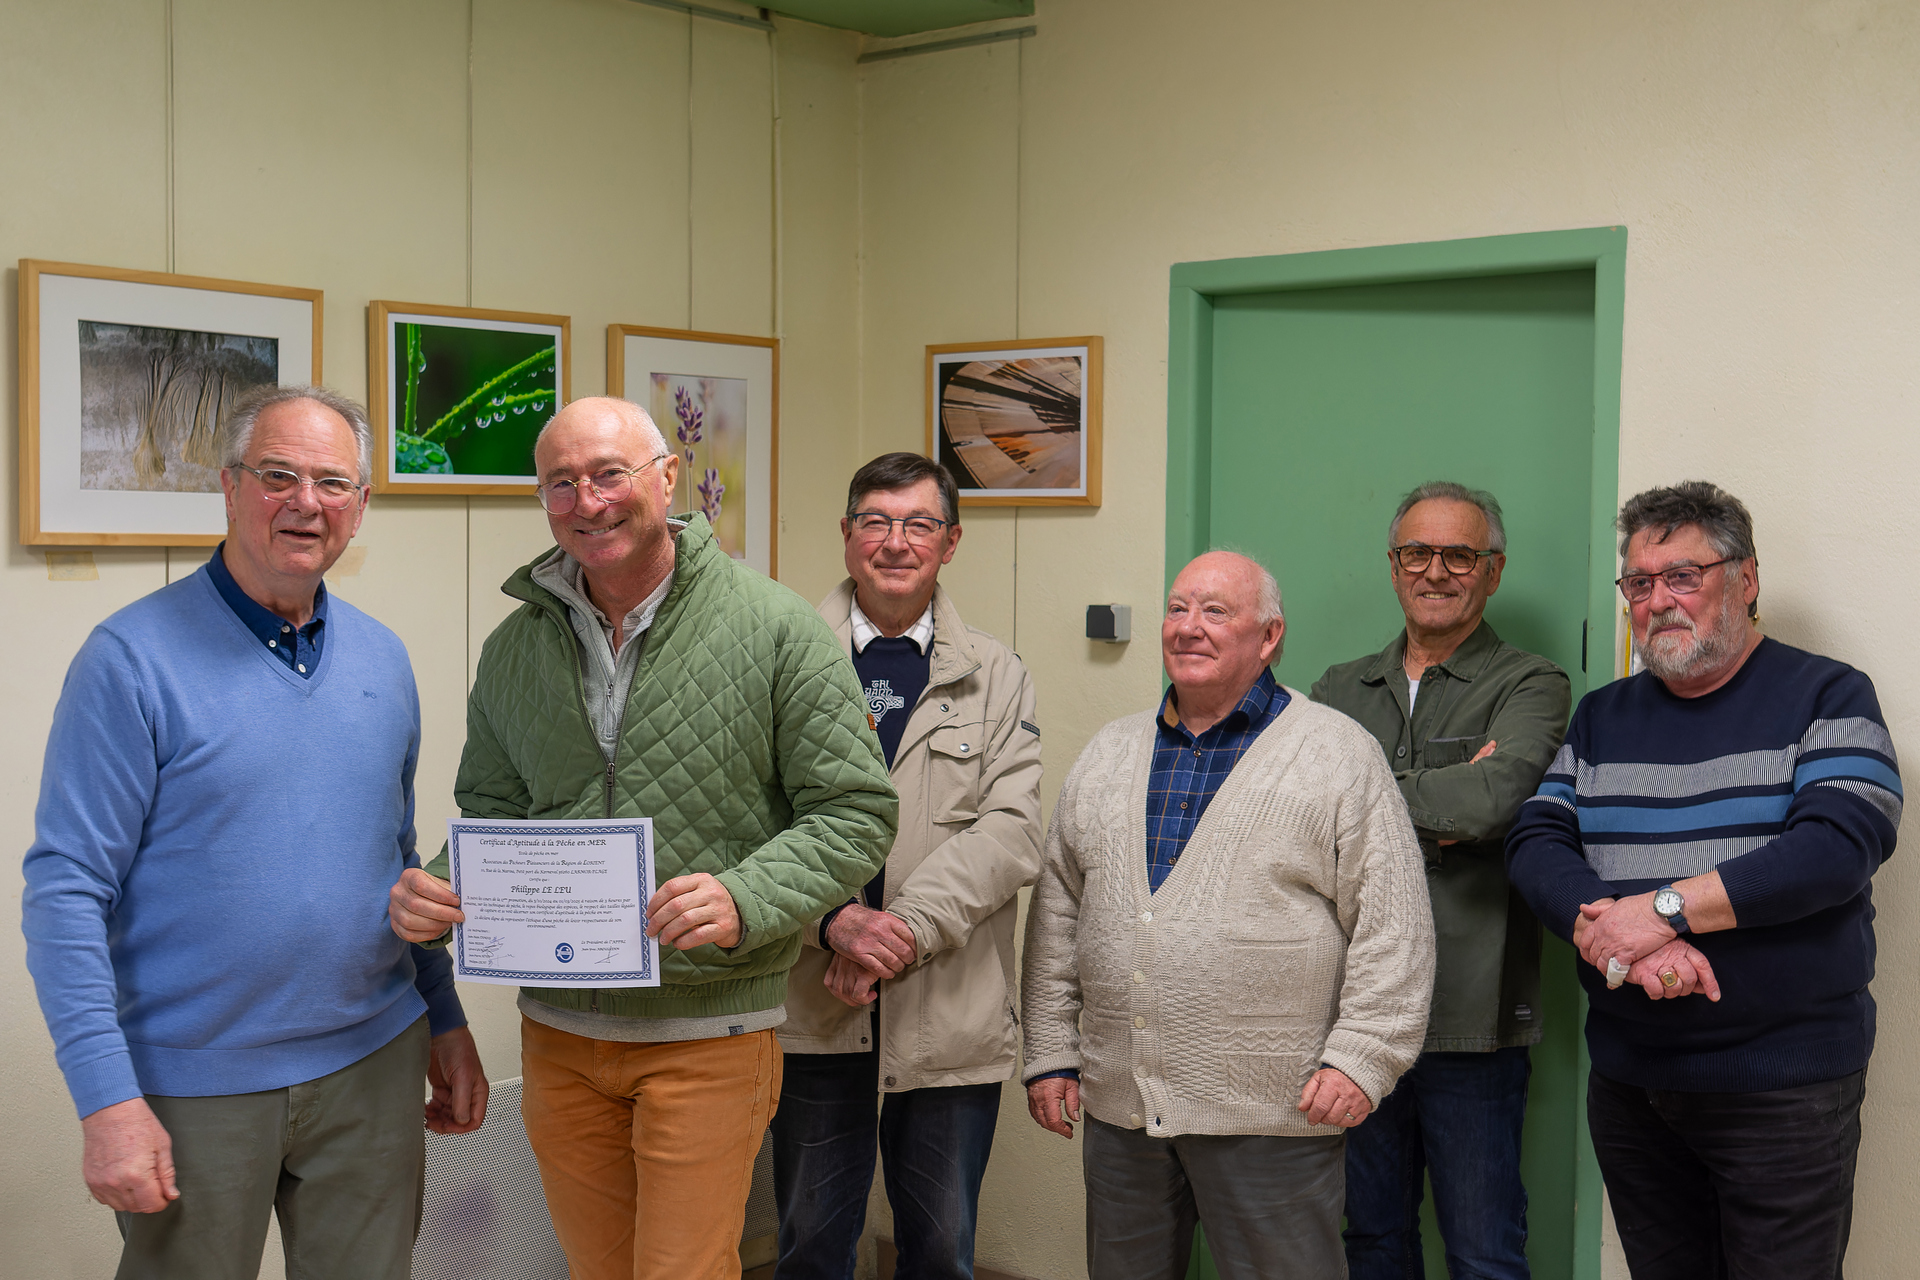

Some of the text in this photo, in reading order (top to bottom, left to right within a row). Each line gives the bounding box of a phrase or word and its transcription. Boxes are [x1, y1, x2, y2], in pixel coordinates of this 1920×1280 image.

[480, 838, 506, 847] Certificat
[507, 839, 540, 848] d'Aptitude
[510, 885, 540, 895] Philippe
